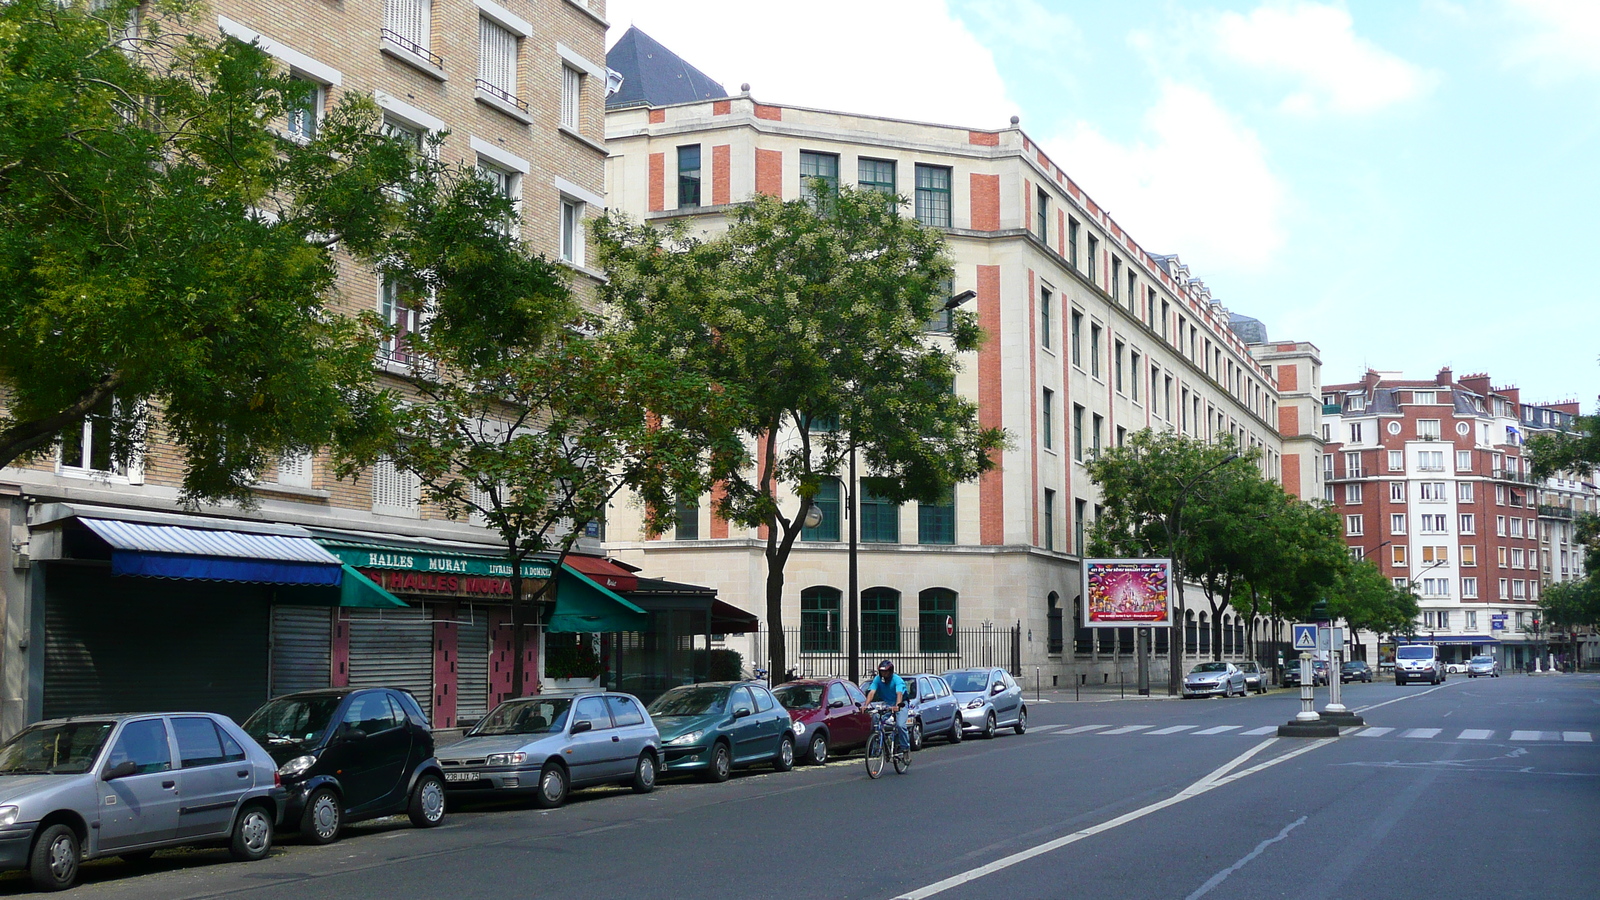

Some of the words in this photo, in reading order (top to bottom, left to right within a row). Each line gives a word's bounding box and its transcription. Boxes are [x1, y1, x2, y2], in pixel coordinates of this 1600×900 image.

[369, 553, 414, 568] HALLES
[429, 557, 468, 572] MURAT
[390, 571, 459, 592] HALLES
[465, 577, 513, 595] MURA
